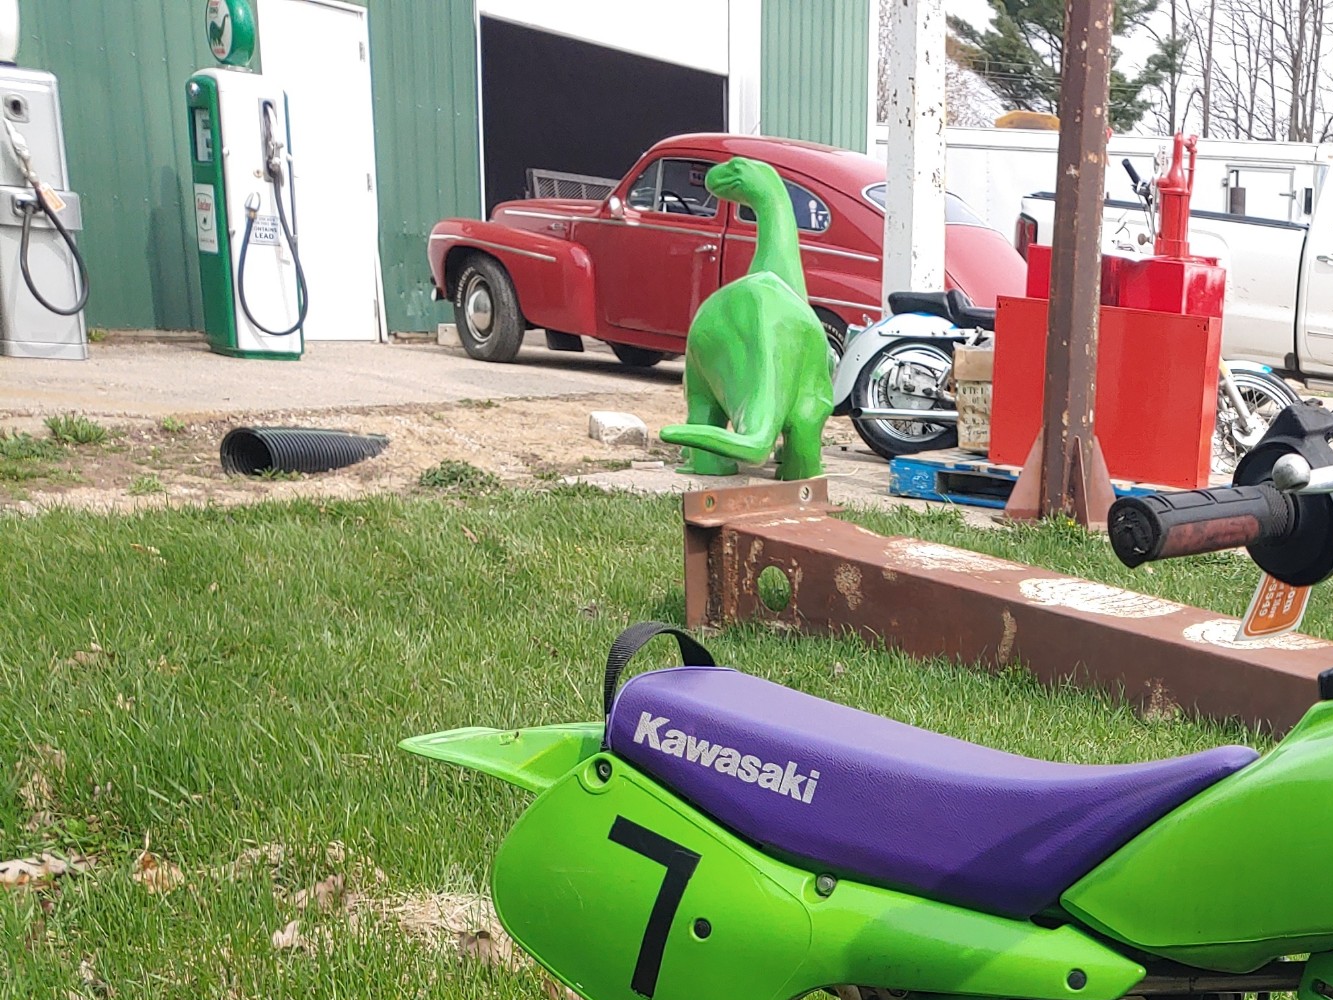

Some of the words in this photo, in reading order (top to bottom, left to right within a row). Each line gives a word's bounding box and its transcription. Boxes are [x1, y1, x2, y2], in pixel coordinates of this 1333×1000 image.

[254, 232, 275, 240] LEAD
[633, 711, 821, 804] Kawasaki
[607, 814, 704, 1000] 7
